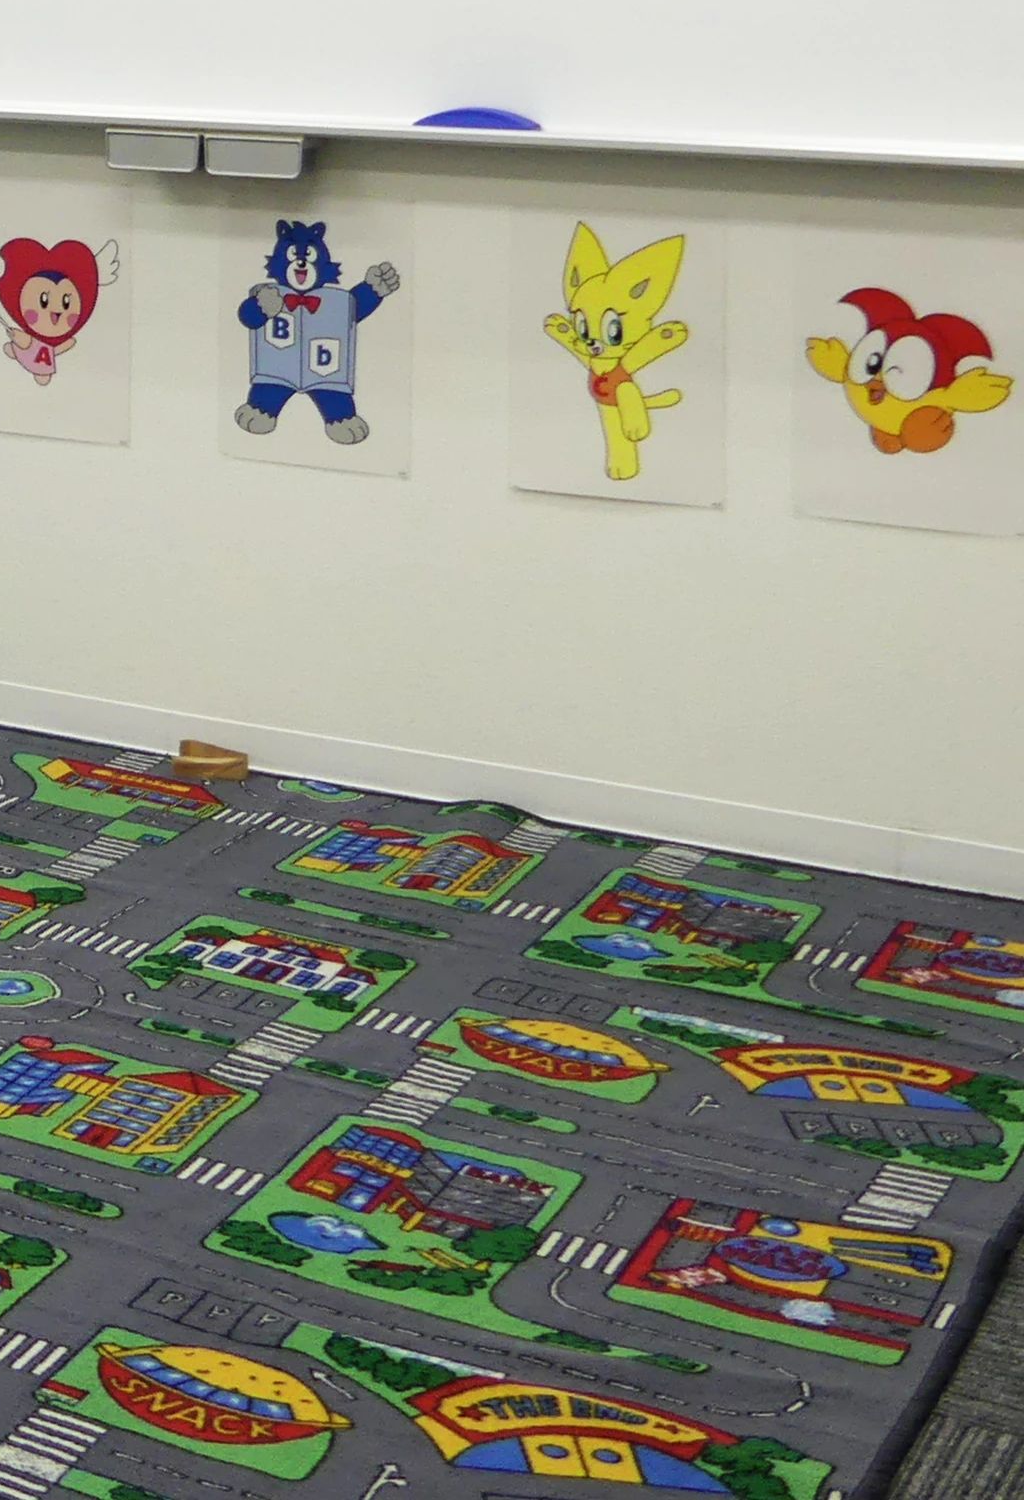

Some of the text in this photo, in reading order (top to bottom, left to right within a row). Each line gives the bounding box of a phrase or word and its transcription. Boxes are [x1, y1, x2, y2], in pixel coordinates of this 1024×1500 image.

[272, 317, 290, 339] B
[33, 346, 52, 366] A
[316, 345, 332, 366] b
[109, 1376, 275, 1438] SNACK
[479, 1394, 561, 1420] THE
